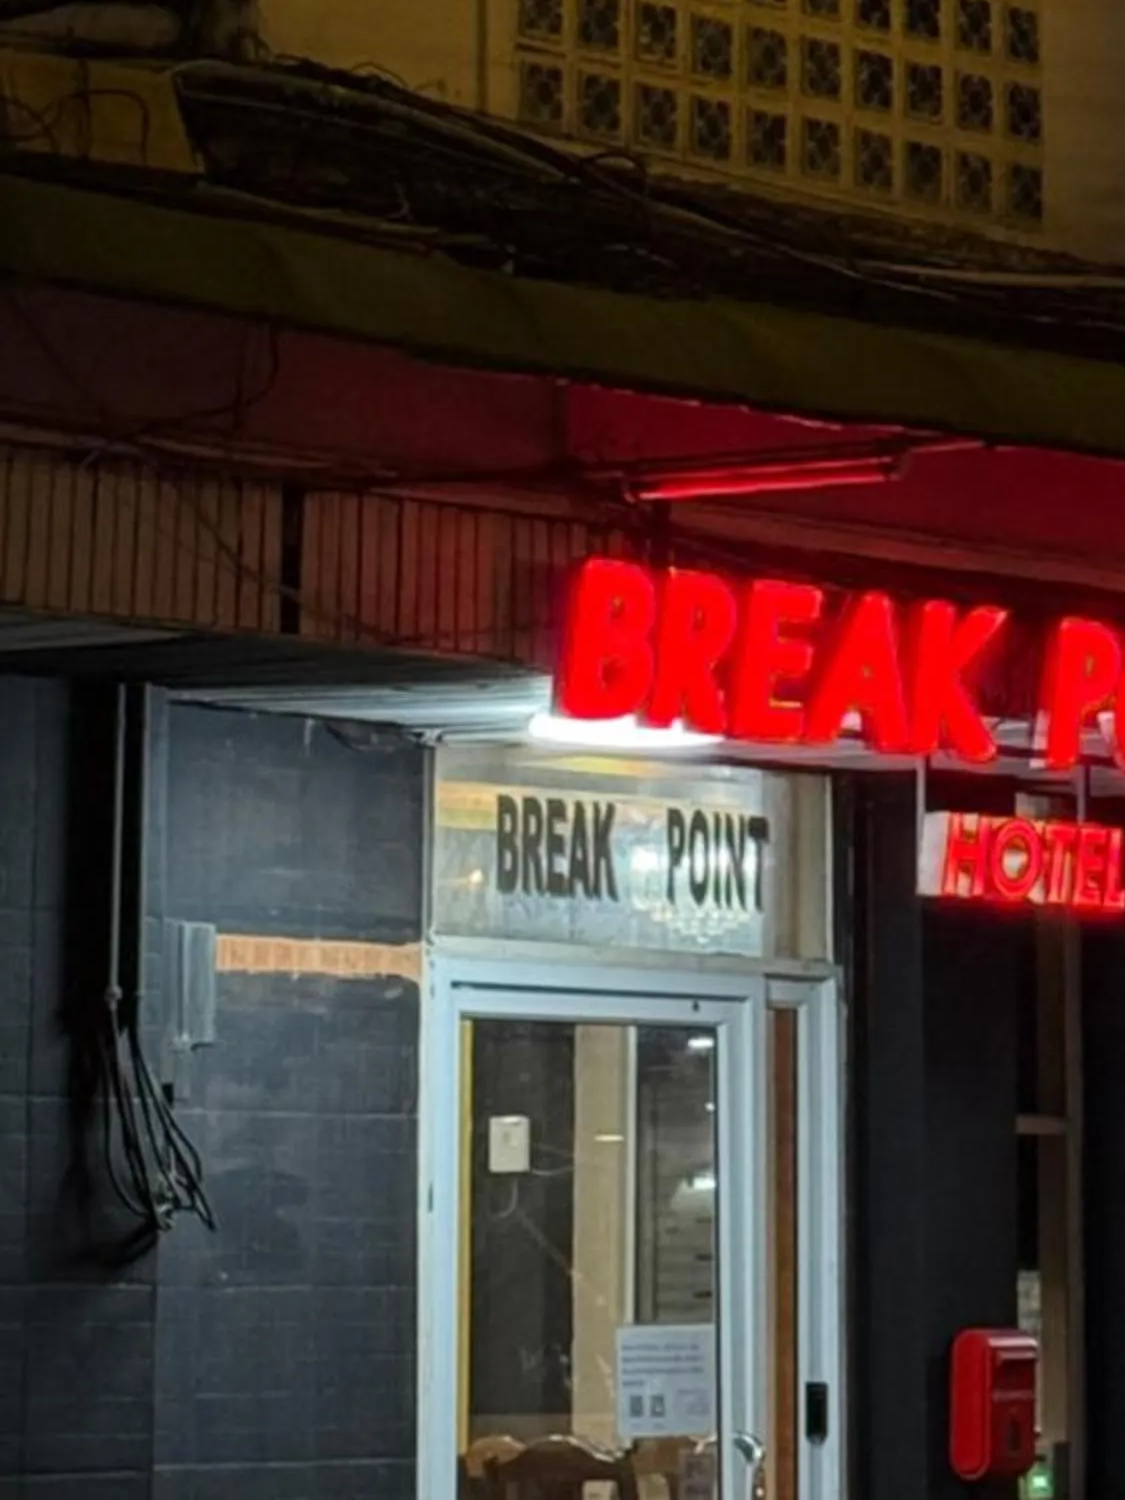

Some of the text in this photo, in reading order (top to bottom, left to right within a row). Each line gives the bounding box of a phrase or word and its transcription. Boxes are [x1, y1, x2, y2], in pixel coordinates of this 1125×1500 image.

[560, 557, 1007, 764] BREAK
[496, 793, 769, 912] BREAK POINT
